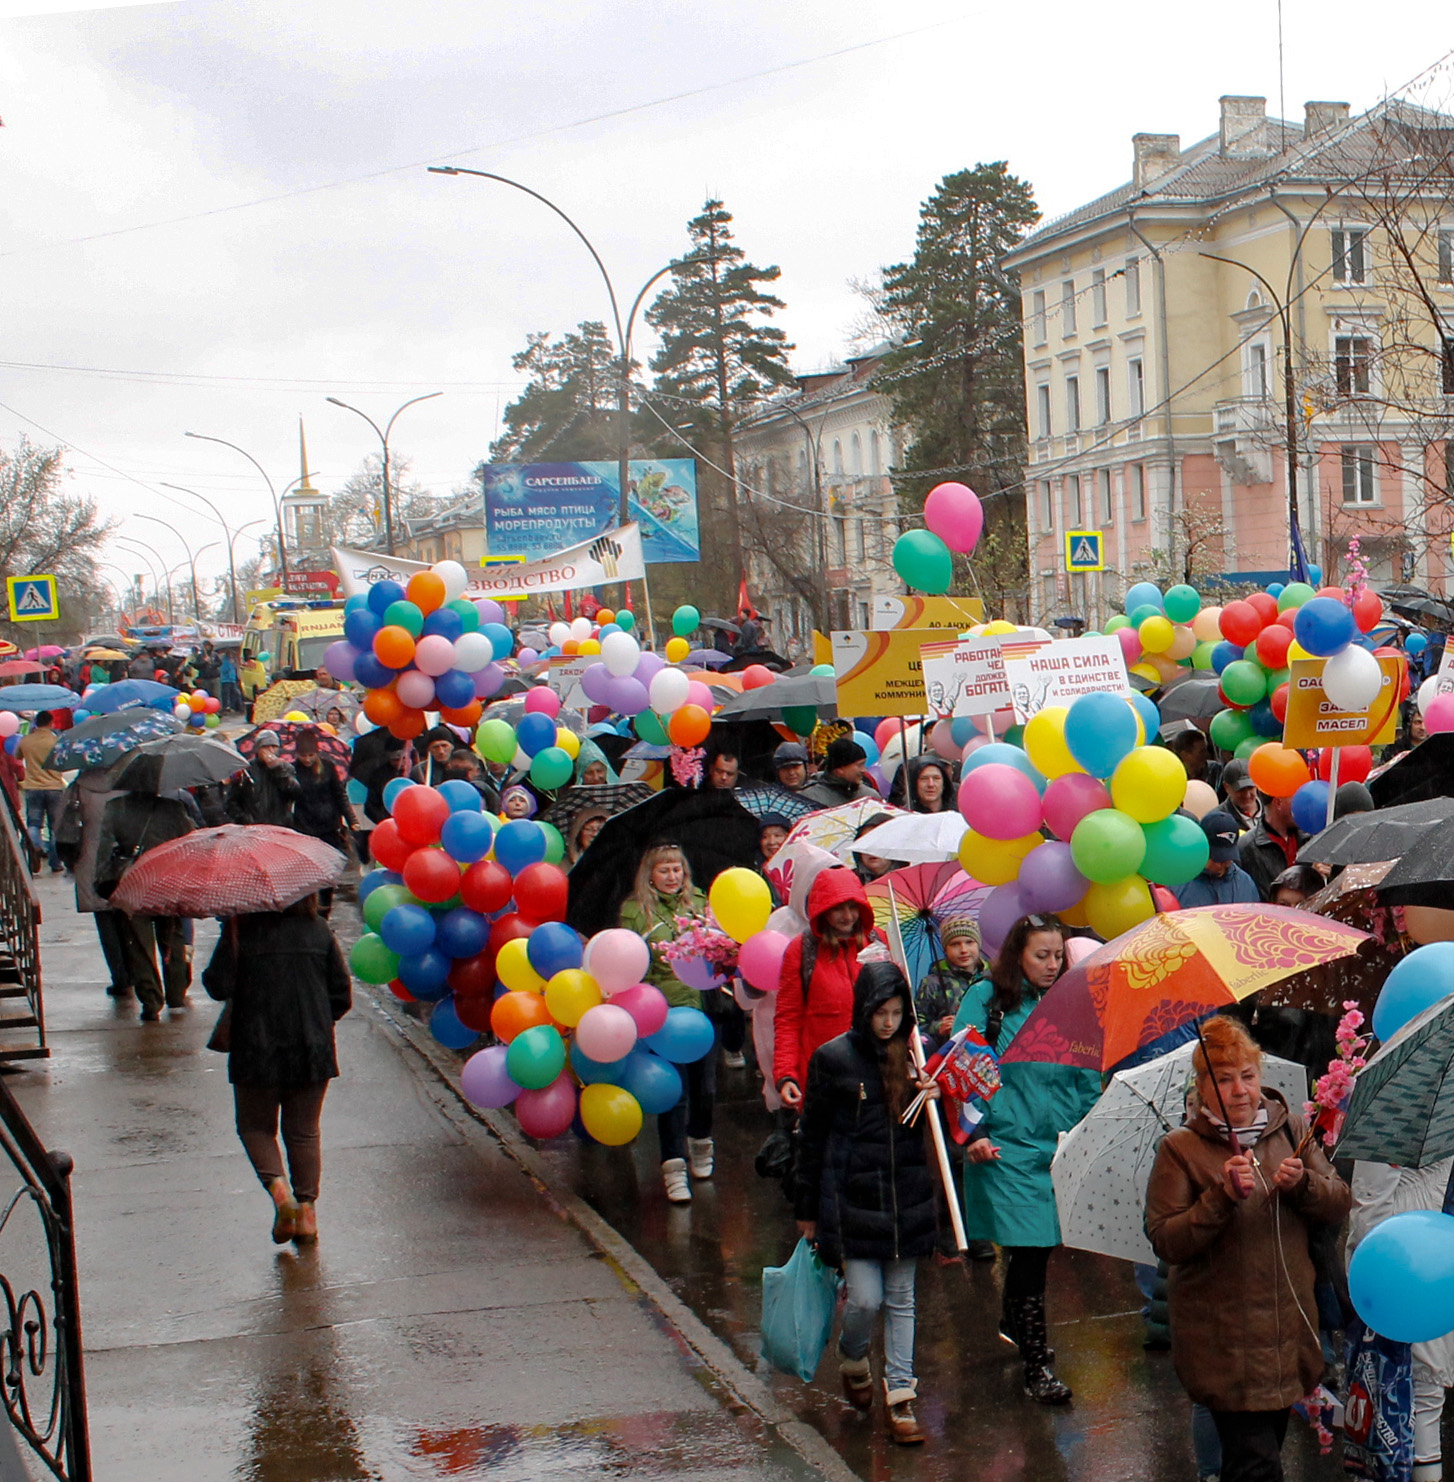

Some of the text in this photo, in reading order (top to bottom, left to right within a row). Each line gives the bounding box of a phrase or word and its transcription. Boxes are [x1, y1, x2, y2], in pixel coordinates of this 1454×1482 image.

[525, 476, 602, 487] САРСЕНБАЕВ
[494, 505, 596, 518] РЫБА МЯСО ПТИЦА
[494, 518, 596, 532] МОРЕПРОДУКТЫ
[1030, 656, 1070, 672] НАША
[1074, 653, 1111, 669] СИЛА
[1059, 671, 1121, 685] В ЕДИНСТВЕ
[1298, 678, 1323, 688] ОА
[1052, 683, 1125, 697] И СОЛИДАРНОСТИ!
[1317, 719, 1367, 731] МАСЕЛ
